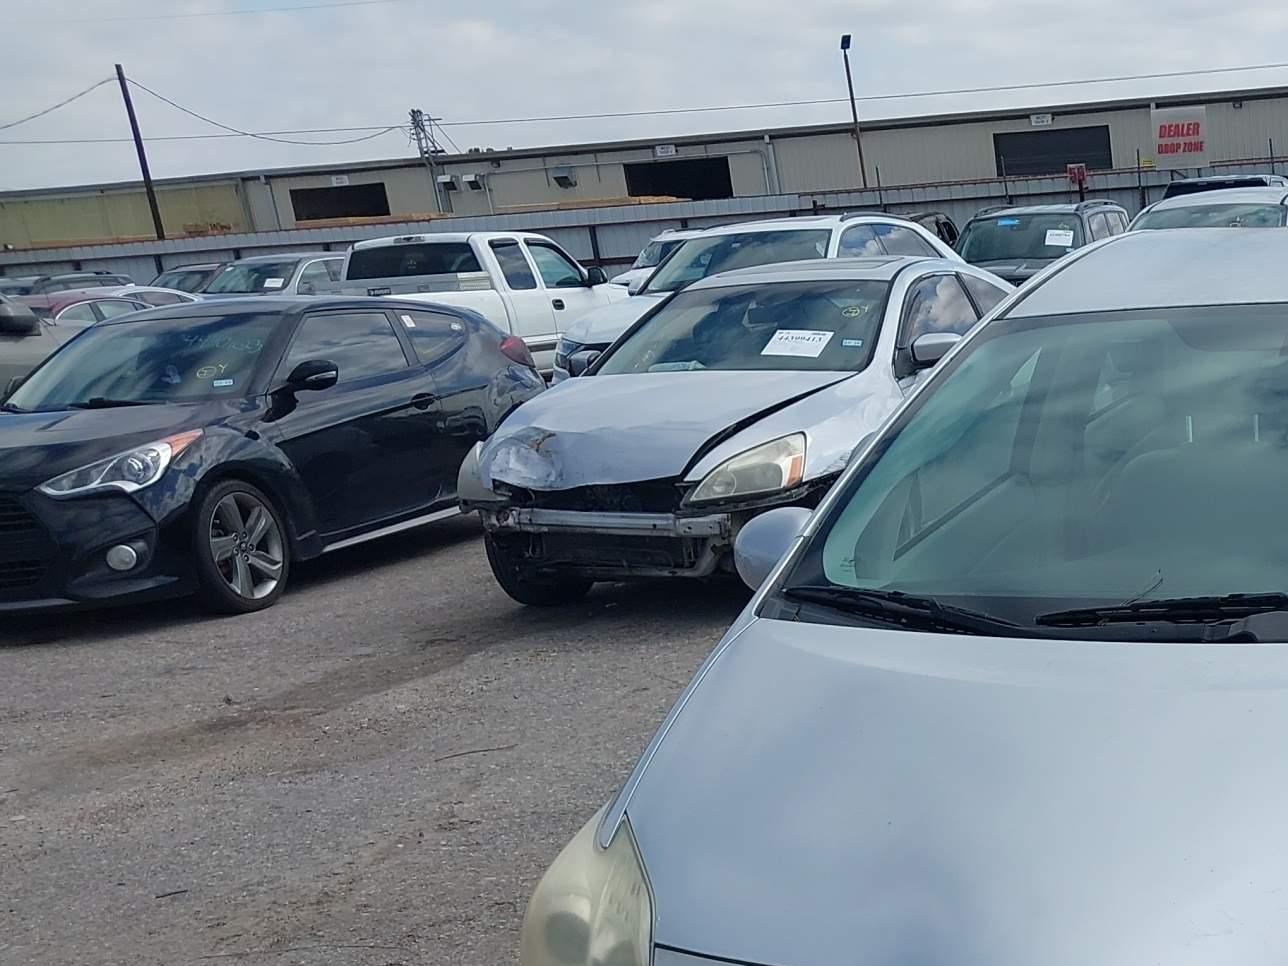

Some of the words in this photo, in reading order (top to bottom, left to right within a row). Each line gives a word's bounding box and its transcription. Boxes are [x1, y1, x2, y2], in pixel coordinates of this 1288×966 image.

[1158, 122, 1201, 139] DEALER
[1157, 143, 1182, 154] DROP
[1182, 141, 1205, 153] ZONE
